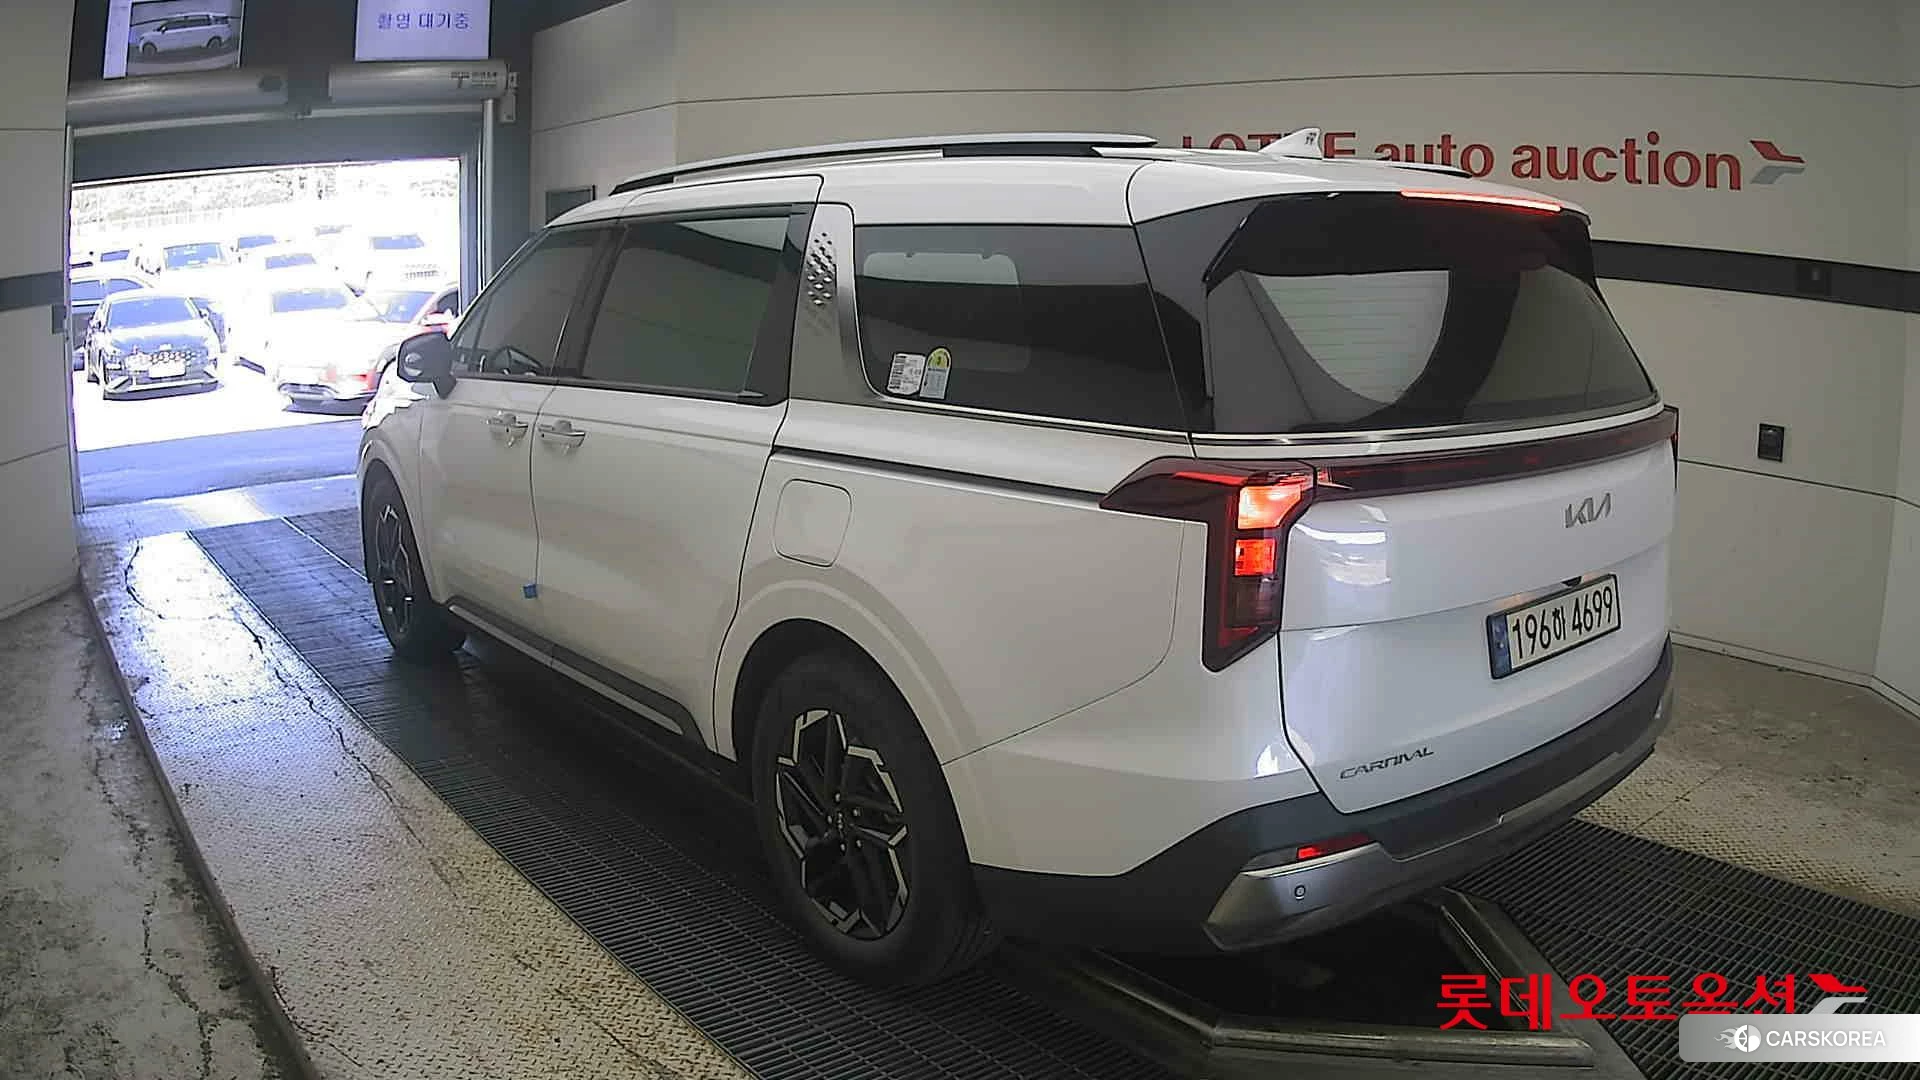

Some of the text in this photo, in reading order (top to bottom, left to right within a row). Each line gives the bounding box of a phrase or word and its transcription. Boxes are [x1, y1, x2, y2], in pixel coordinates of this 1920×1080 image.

[419, 12, 469, 30] 대기중
[1511, 130, 1742, 191] auction
[1572, 586, 1613, 636] 4699
[1340, 747, 1434, 779] CARNIVAL
